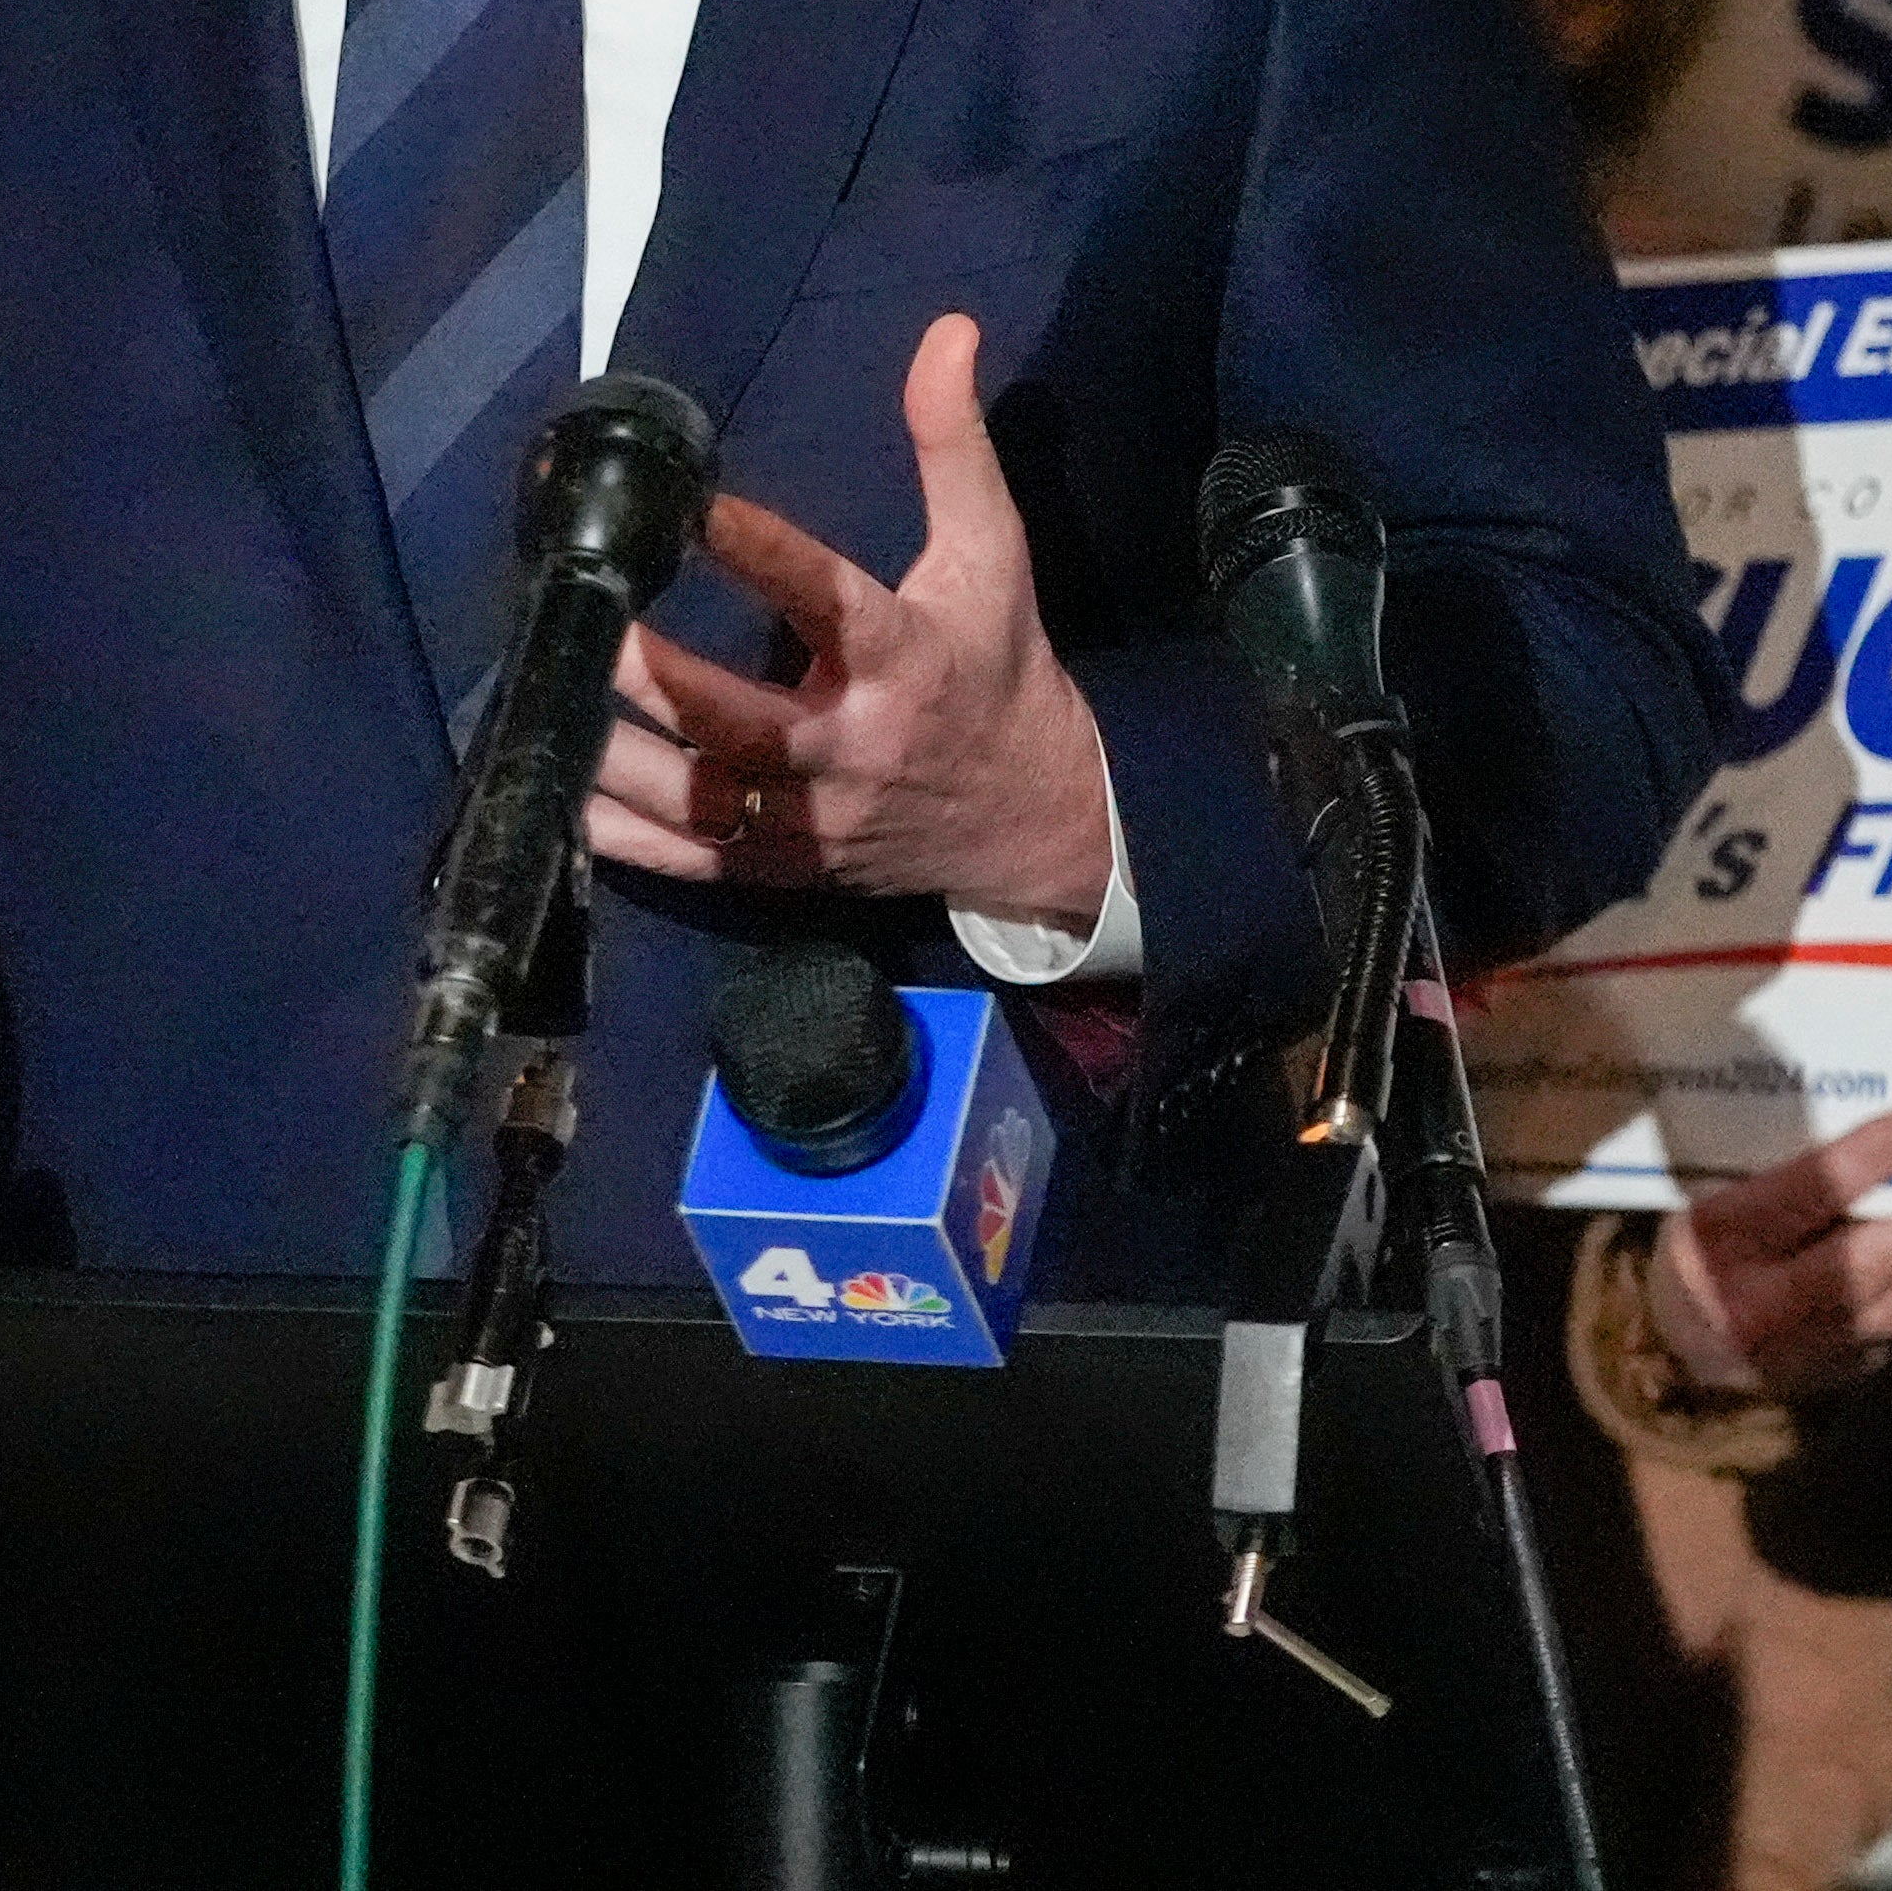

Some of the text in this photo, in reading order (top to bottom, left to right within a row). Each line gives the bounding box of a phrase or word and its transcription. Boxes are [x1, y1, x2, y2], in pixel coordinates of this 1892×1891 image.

[738, 1246, 836, 1308] 4
[753, 1306, 956, 1329] NEW YORK
